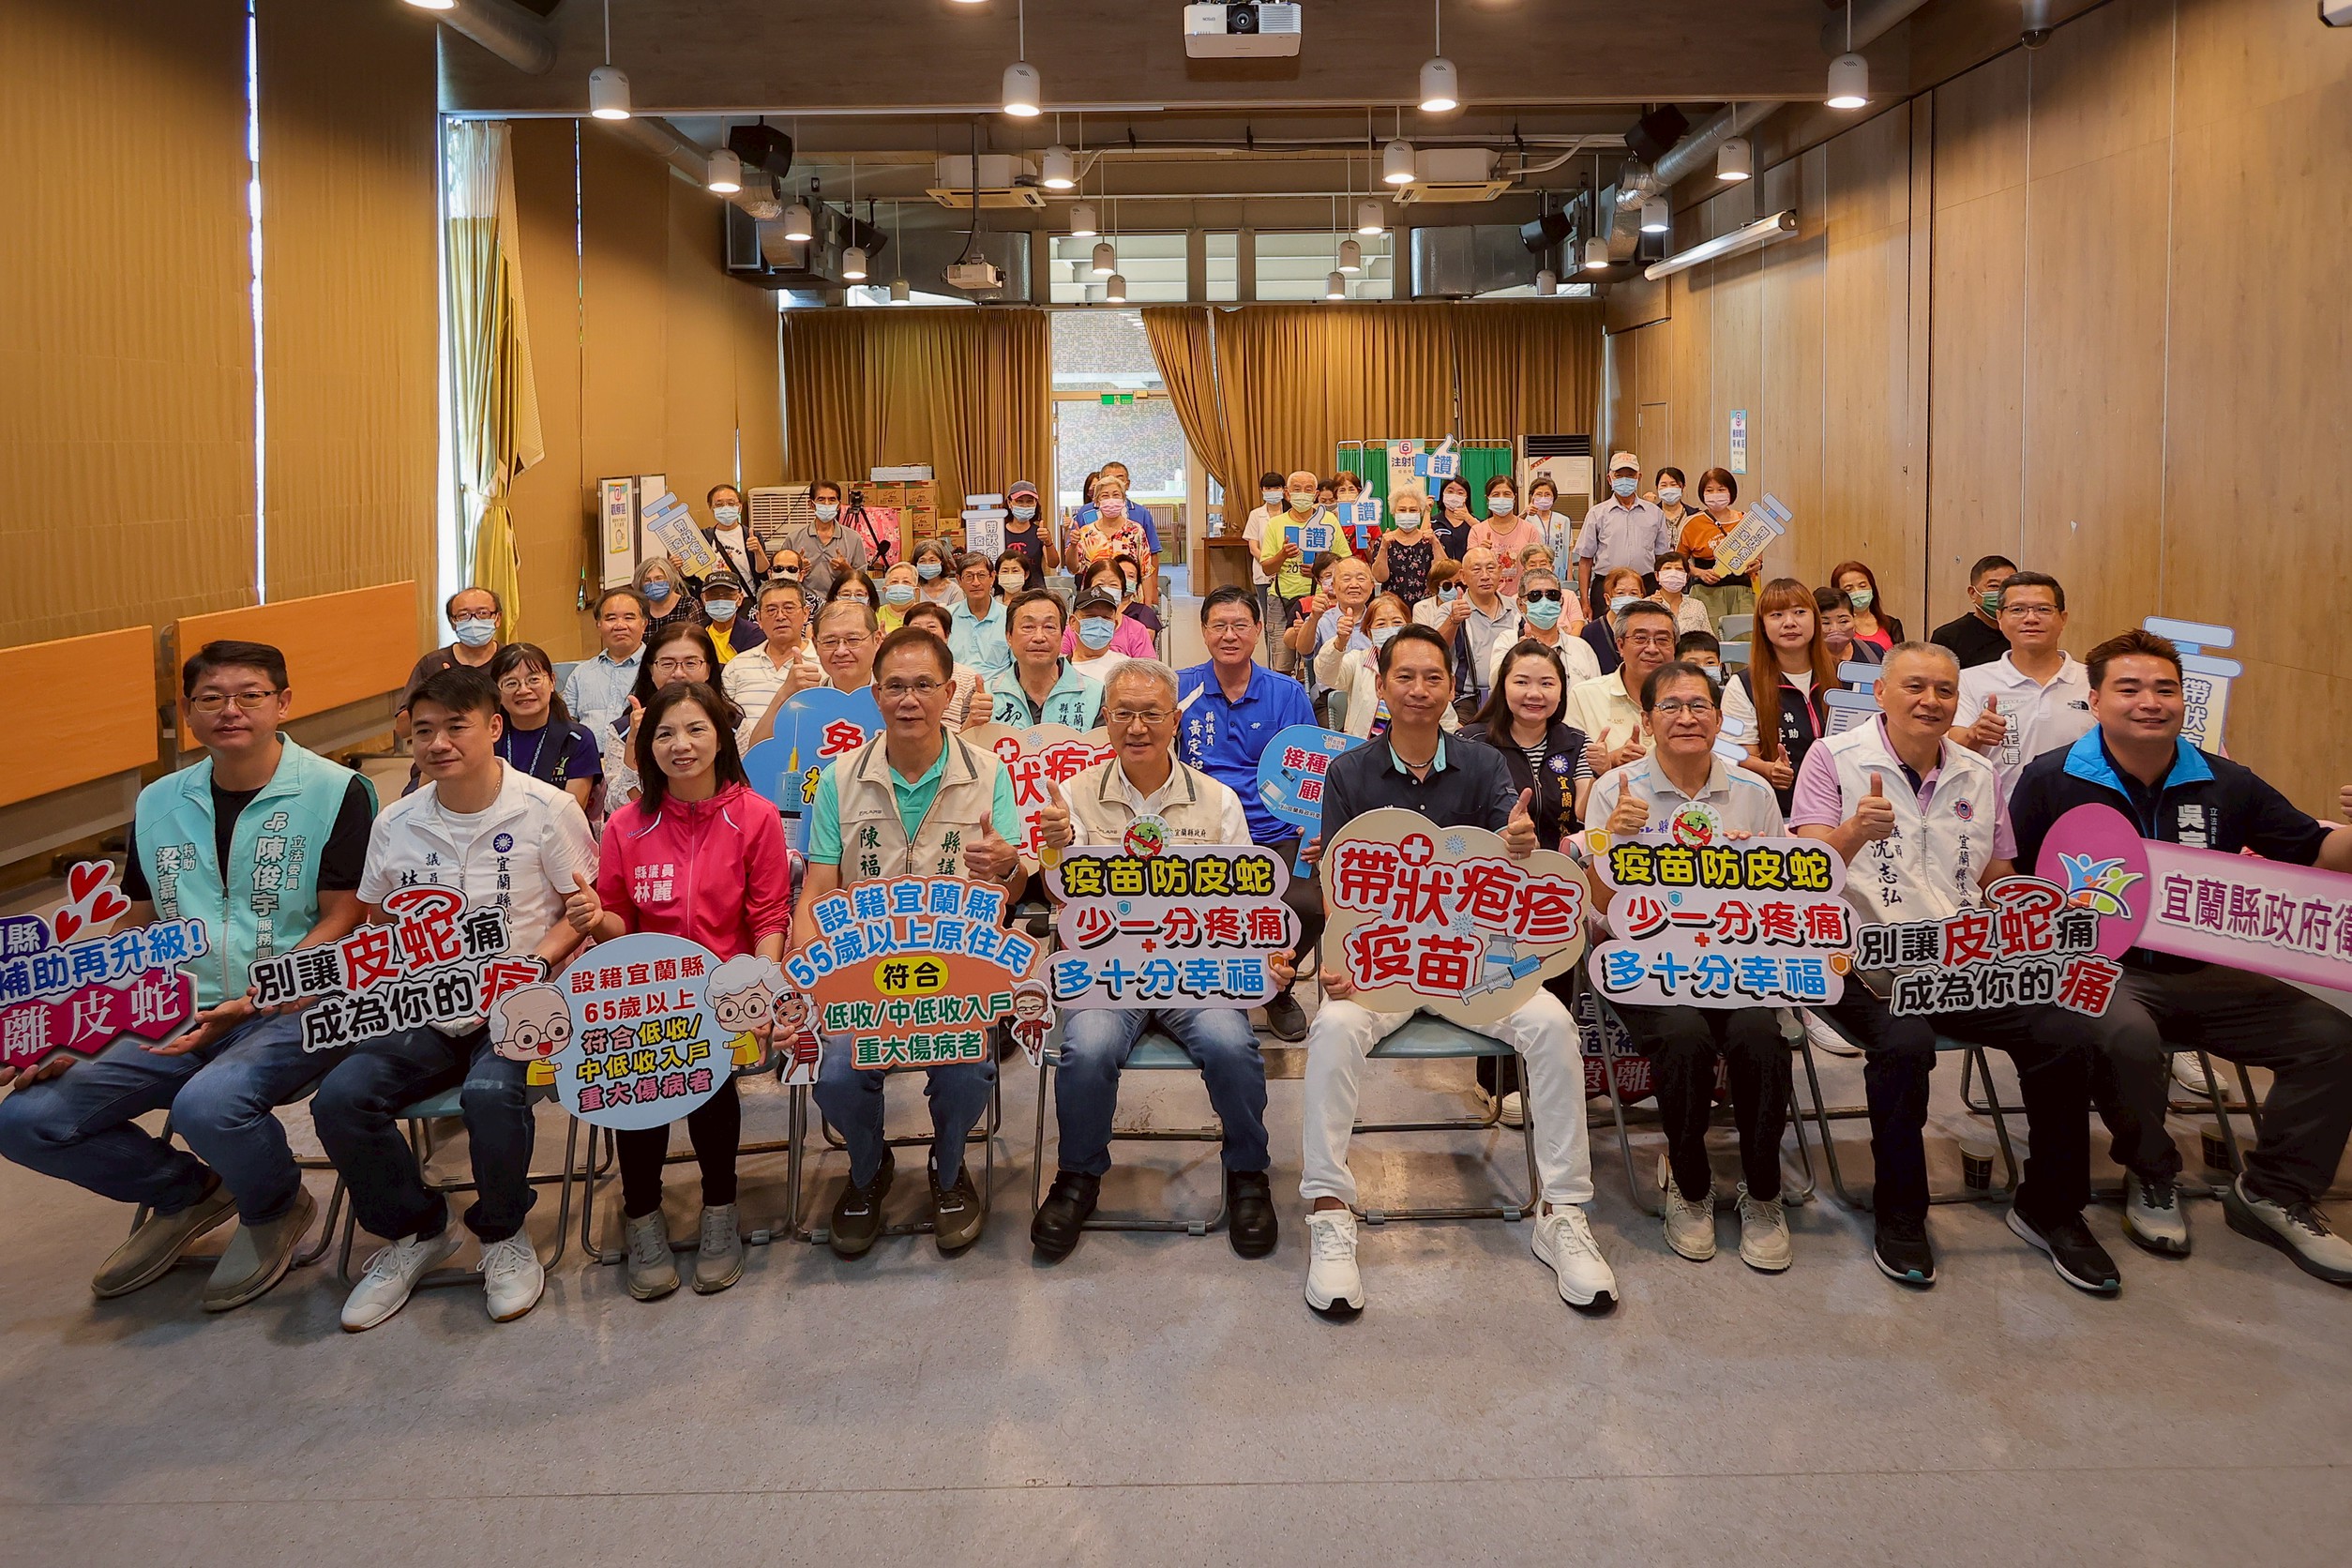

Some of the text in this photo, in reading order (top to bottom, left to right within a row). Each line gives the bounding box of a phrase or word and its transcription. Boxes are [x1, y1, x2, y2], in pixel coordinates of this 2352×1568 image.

[1392, 457, 1415, 467] 注射
[1401, 443, 1410, 452] 6
[1433, 455, 1453, 475] 讚
[1357, 502, 1376, 521] 讚
[986, 520, 999, 560] 帶狀疱
[1305, 527, 1326, 549] 讚
[1073, 701, 1085, 733] 宜蘭
[1205, 711, 1216, 746] 縣議員
[1784, 712, 1799, 739] 特助
[1283, 746, 1332, 776] 接種
[1298, 779, 1323, 803] 顧
[182, 842, 197, 872] 特助
[285, 836, 306, 890] 立法委員
[860, 825, 882, 878] 陳福
[1611, 846, 1831, 889] 疫苗防皮蛇
[495, 856, 512, 924] 宜蘭縣
[635, 864, 674, 880] 縣議員
[1063, 857, 1273, 895] 疫苗防皮蛇
[1870, 839, 1903, 908] 沈志弘
[634, 880, 673, 903] 林麗
[816, 882, 1000, 934] 設籍宜蘭縣
[1341, 848, 1576, 937] 帶狀疱疹
[0, 921, 40, 955] 縣
[1077, 906, 1283, 942] 少一分疼痛
[1625, 897, 1845, 942] 少一分疼痛
[1861, 901, 2095, 968] 別讓皮蛇痛
[257, 906, 506, 1004] 別讓皮蛇痛
[788, 918, 1033, 987] 55歲以上原住民
[1351, 924, 1475, 990] 疫苗
[570, 954, 705, 994] 設籍宜蘭縣
[882, 961, 941, 990] 符合
[1057, 957, 1265, 994] 多十分幸福
[1609, 950, 1827, 996] 多十分幸福
[1897, 958, 2120, 1014] 成為你的痛
[2, 972, 182, 1061] 離皮蛇
[584, 988, 696, 1023] 65歲以上
[823, 992, 1012, 1030] 低收/中低收入戶
[581, 1013, 702, 1055] 符合低收/
[856, 1032, 982, 1064] 重大傷病者
[577, 1040, 711, 1083] 中低收入戶
[579, 1068, 714, 1113] 重大傷病者
